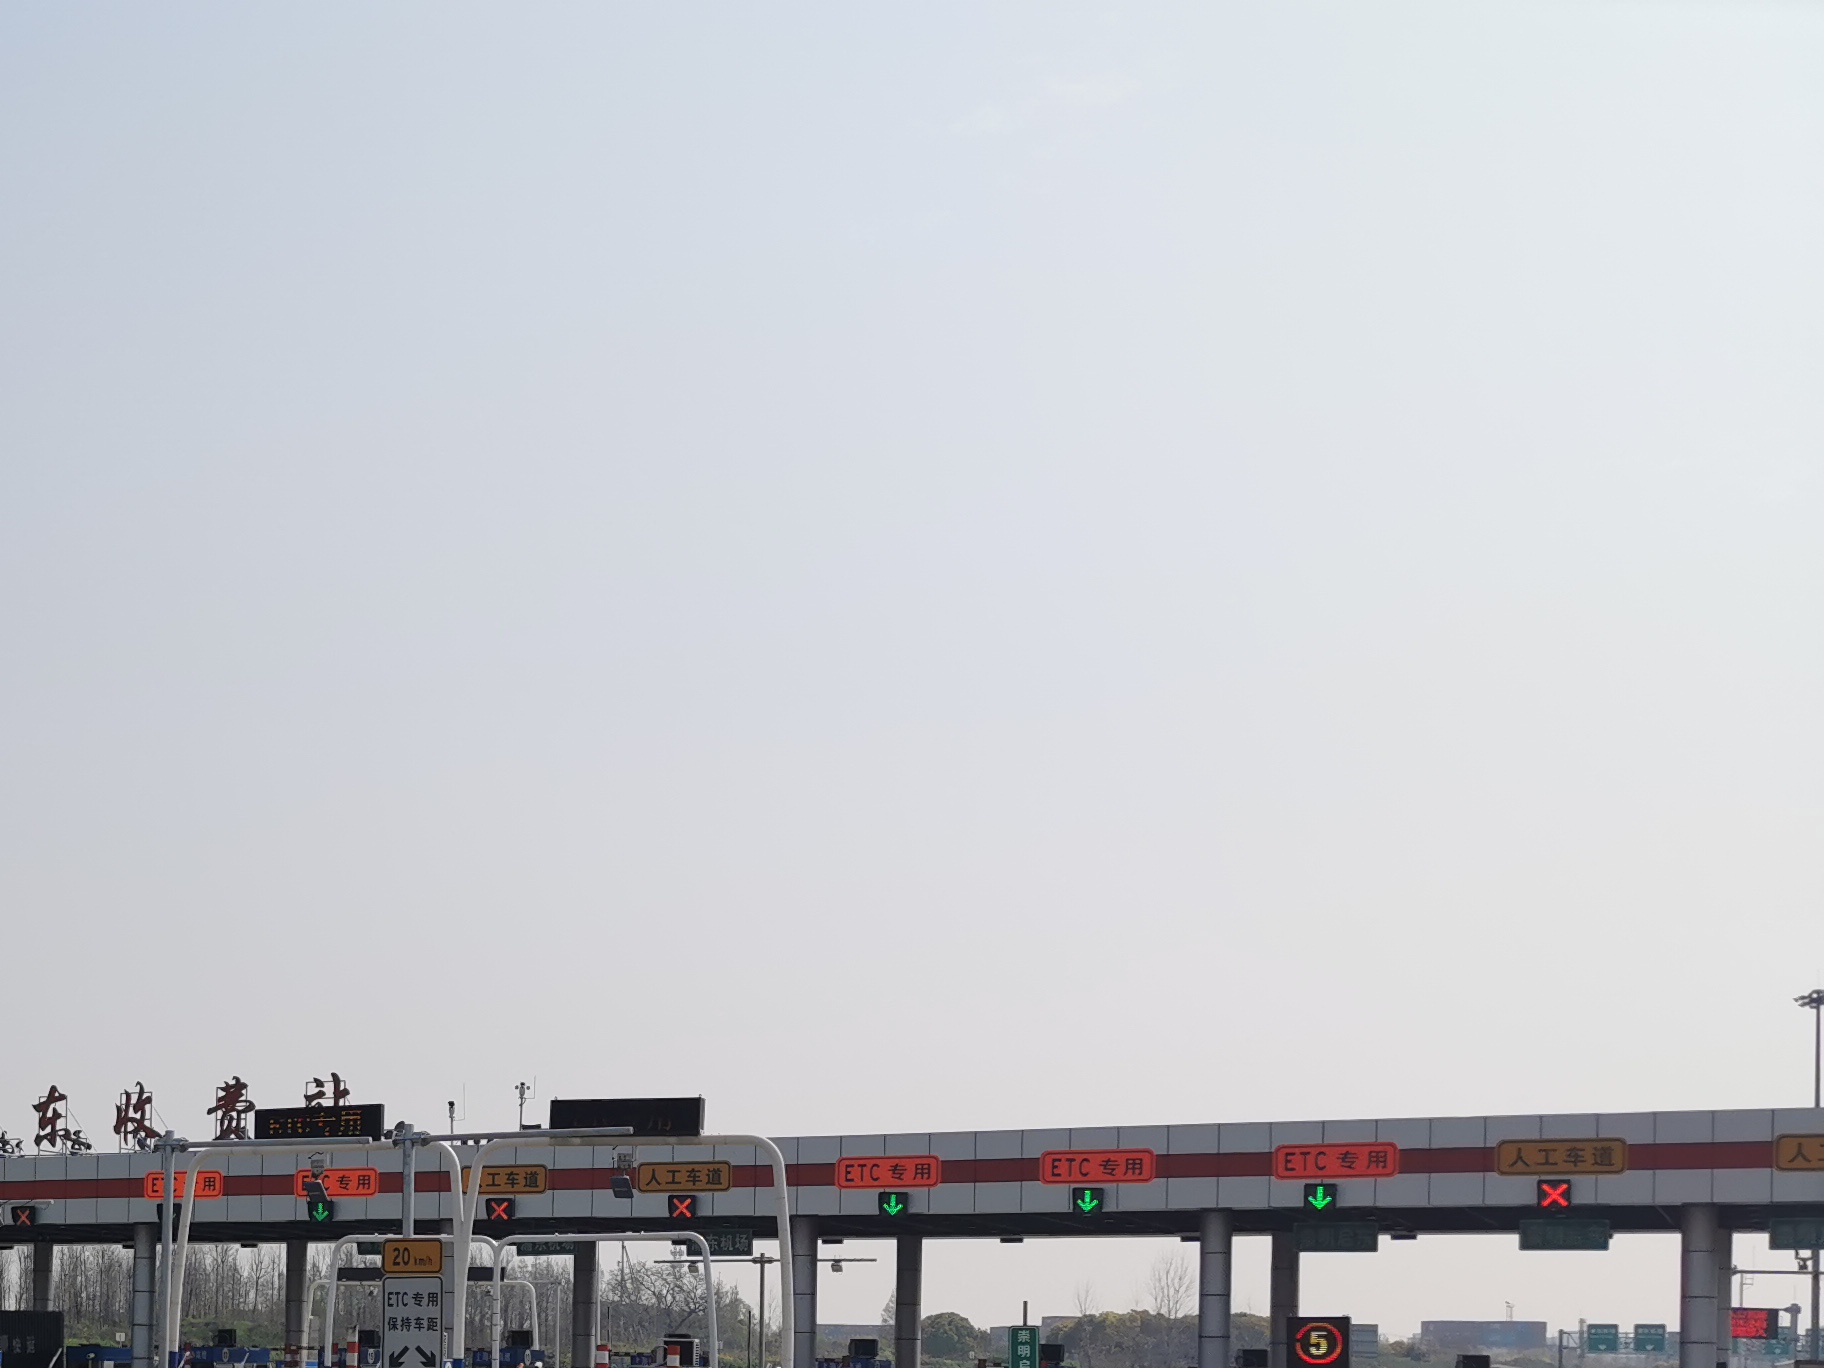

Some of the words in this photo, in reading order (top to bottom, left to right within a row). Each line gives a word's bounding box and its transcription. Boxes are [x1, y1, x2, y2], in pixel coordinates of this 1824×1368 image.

[1051, 1158, 1090, 1177] ETC
[1099, 1157, 1143, 1177] 专用
[1284, 1152, 1327, 1172] ETC
[1336, 1151, 1388, 1171] 专用
[1508, 1148, 1615, 1168] 人工车道
[466, 1172, 540, 1189] 工车道
[645, 1168, 723, 1187] 人工车道
[844, 1164, 880, 1182] ETC
[887, 1163, 931, 1182] 专用
[302, 1174, 330, 1191] EC
[336, 1174, 371, 1191] 专用
[392, 1247, 410, 1266] 20
[387, 1291, 408, 1307] ETC
[412, 1291, 438, 1307] 专用
[387, 1316, 438, 1332] 保持车距
[1309, 1331, 1328, 1355] 5
